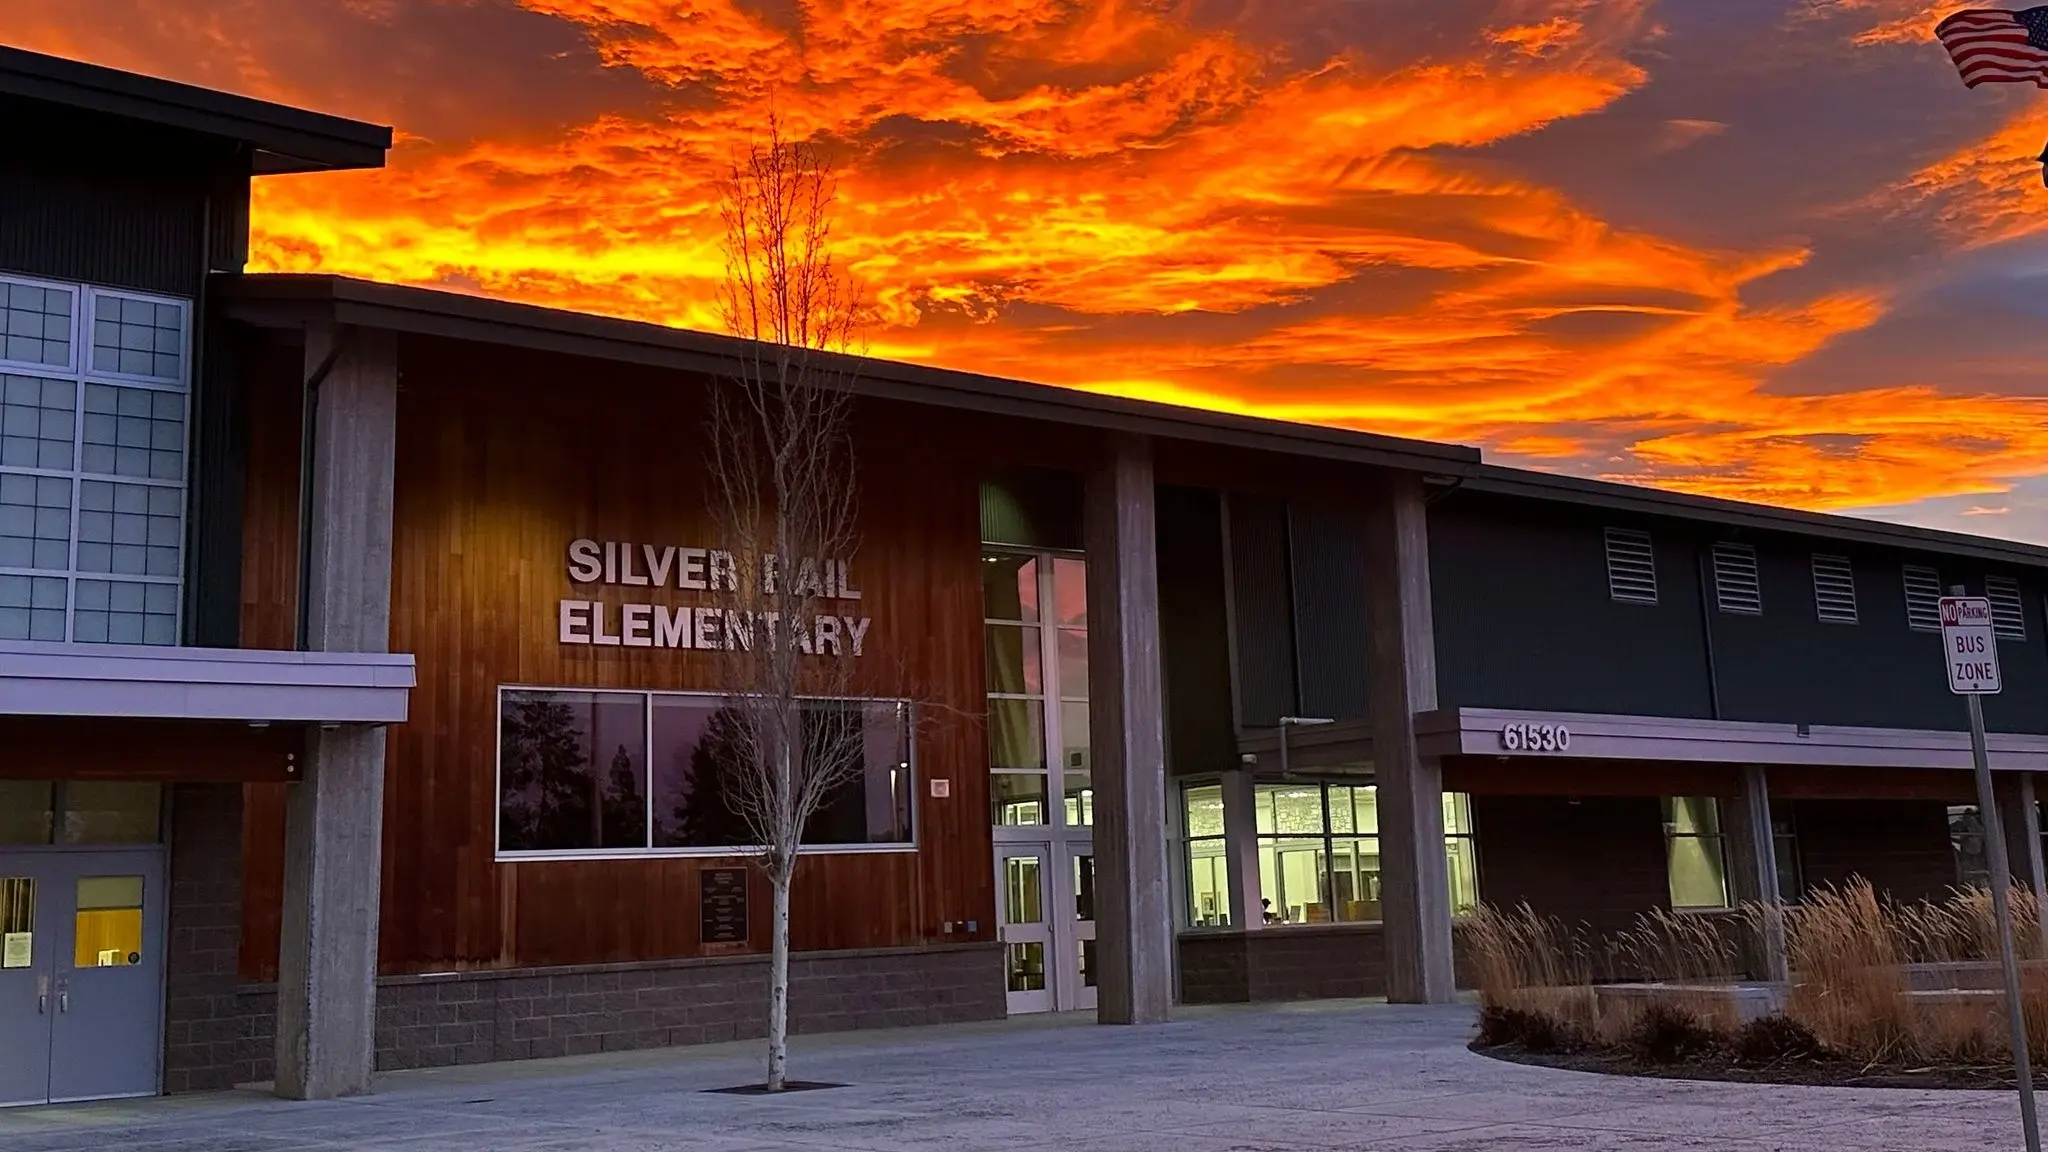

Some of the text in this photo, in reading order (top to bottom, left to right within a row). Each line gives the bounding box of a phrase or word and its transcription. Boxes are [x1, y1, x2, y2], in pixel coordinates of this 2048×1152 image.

[568, 538, 738, 592] SILVER
[1941, 603, 1988, 622] NO PARKING
[1956, 635, 1985, 653] BUS
[1956, 662, 1993, 680] ZONE
[1504, 723, 1570, 751] 61530
